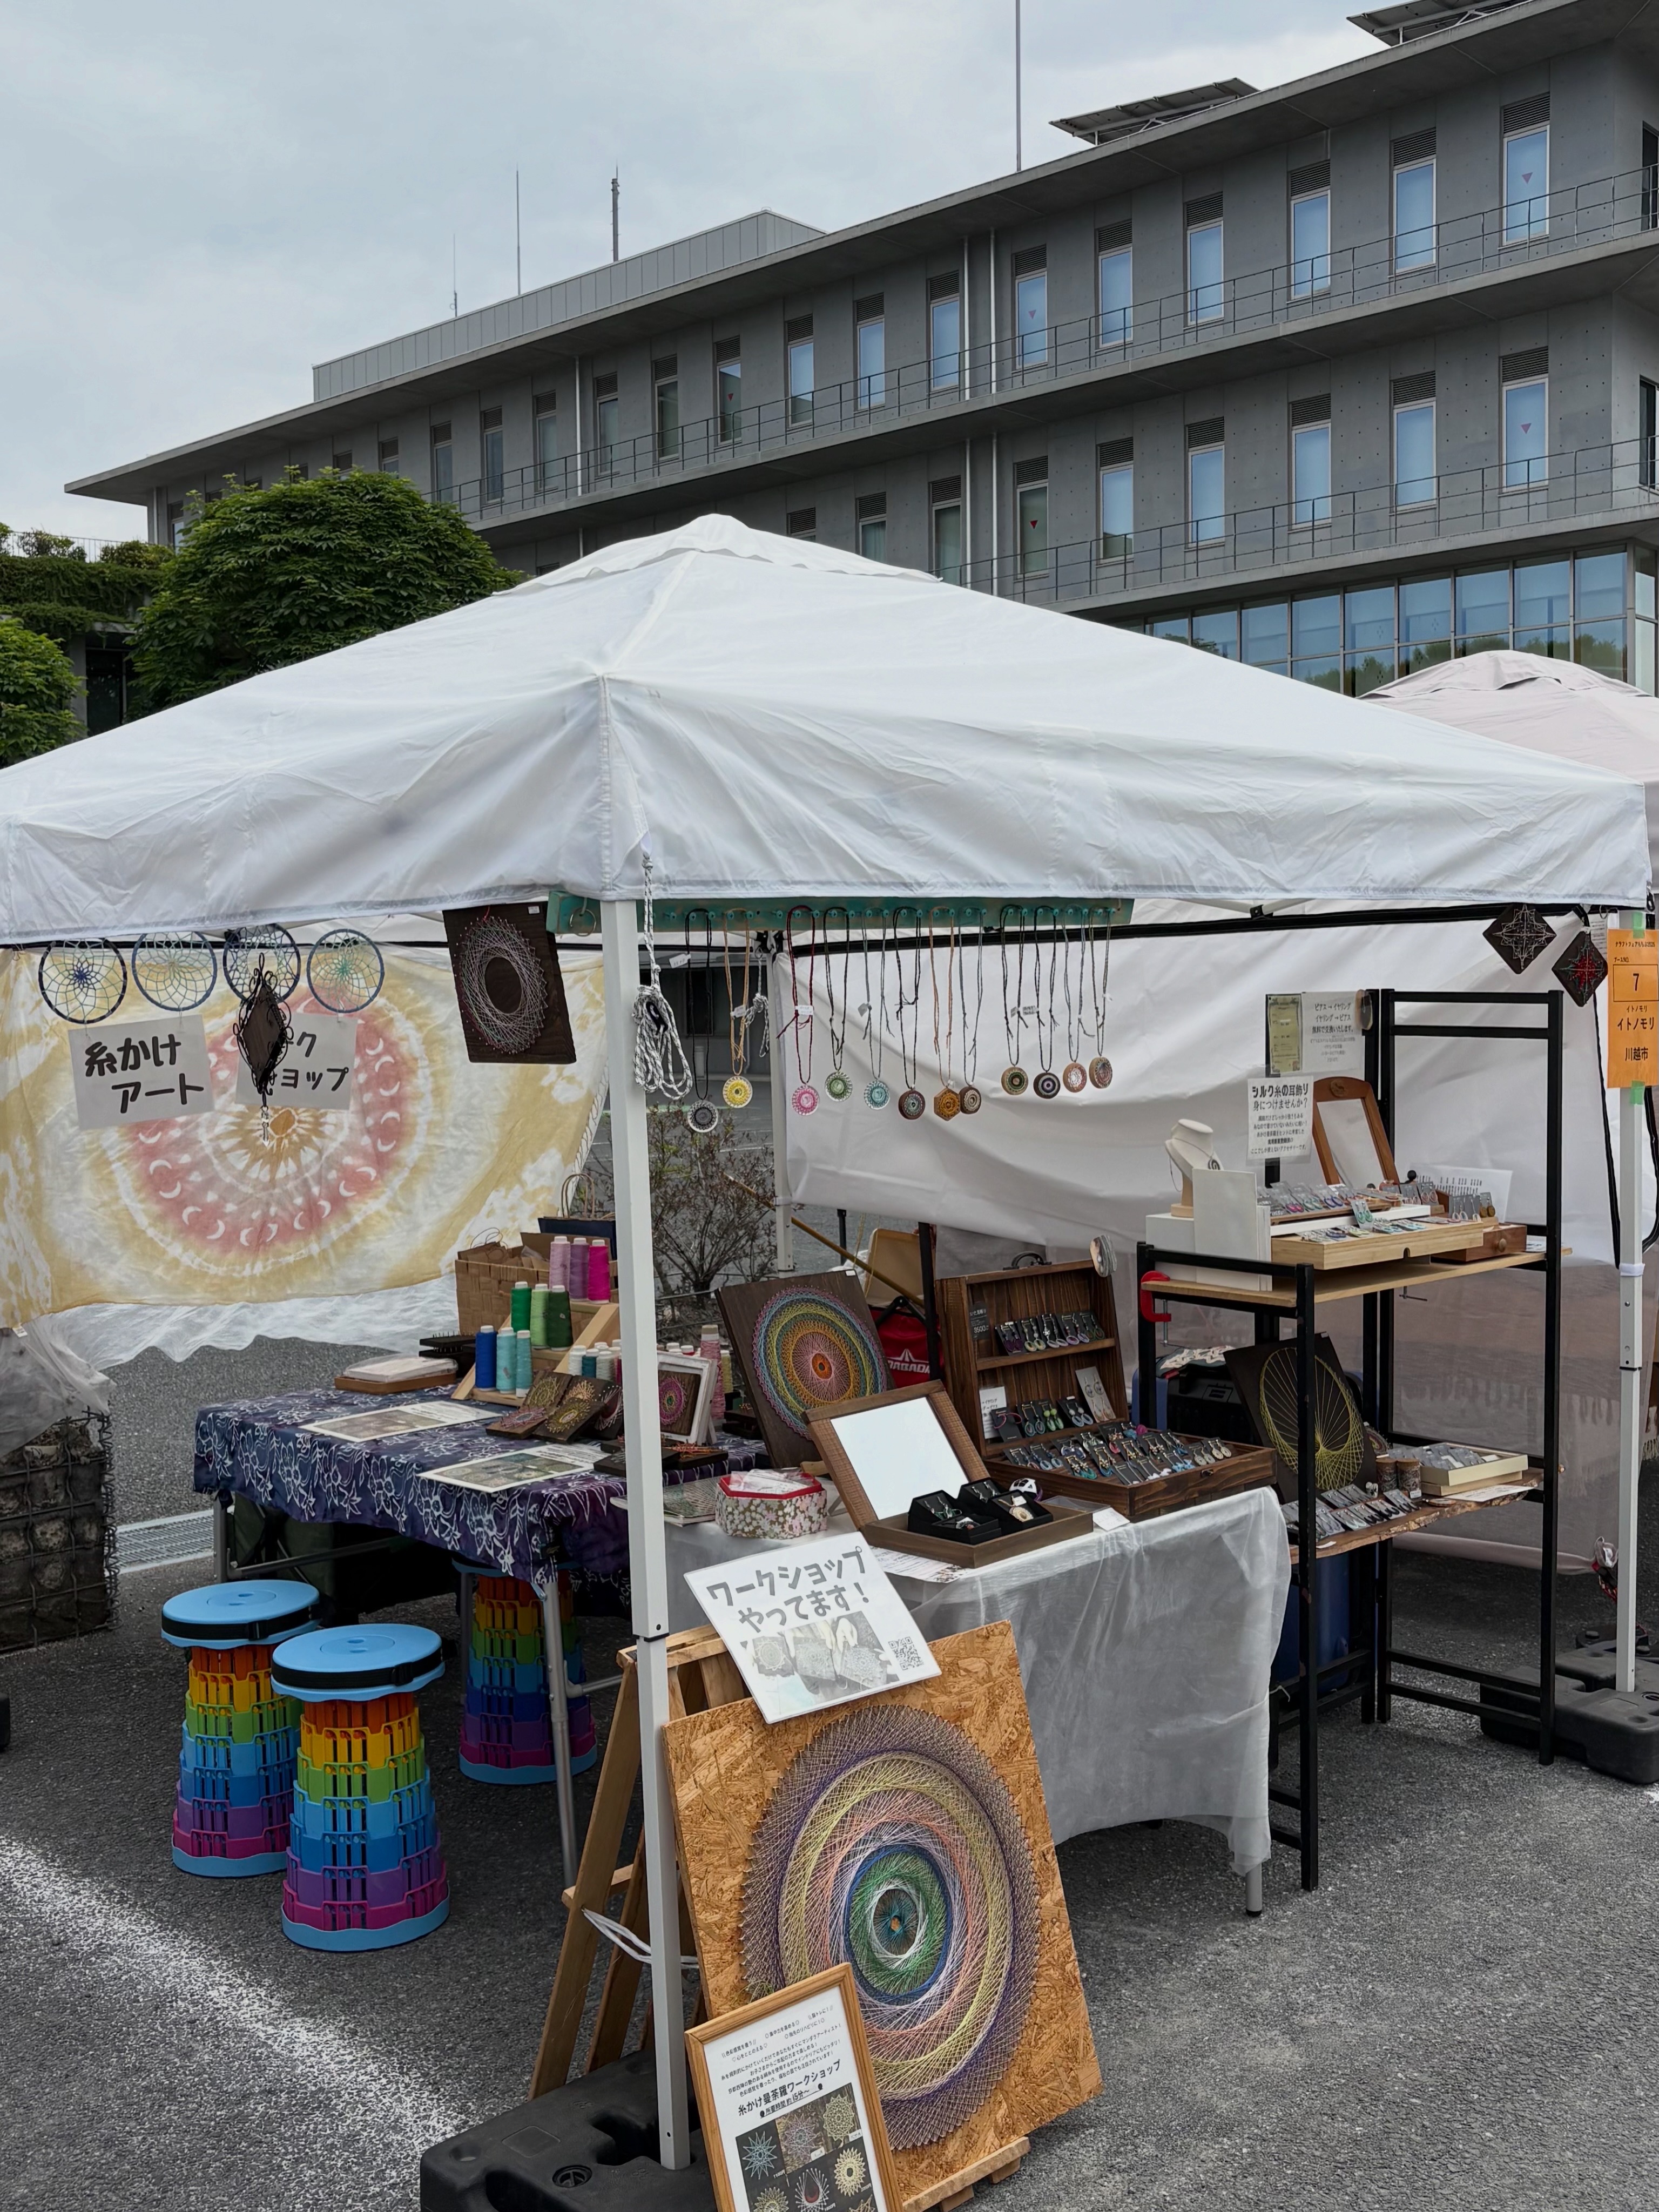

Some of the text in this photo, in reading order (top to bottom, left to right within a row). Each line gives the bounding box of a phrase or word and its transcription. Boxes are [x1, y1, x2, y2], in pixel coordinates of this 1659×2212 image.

[1633, 973, 1640, 991] 7
[1617, 1016, 1654, 1031] イトノモリ
[84, 1033, 181, 1077] 糸かけ
[1625, 1046, 1648, 1062] 川越市
[111, 1073, 204, 1114] アート
[1252, 1083, 1308, 1098] シルク糸の耳飾り
[1253, 1097, 1307, 1111] 身につけませんか？
[706, 1546, 866, 1606] ワークショップ
[738, 1582, 869, 1633] やってます！
[738, 2059, 841, 2116] 糸かけ曼荼羅ワークショップ
